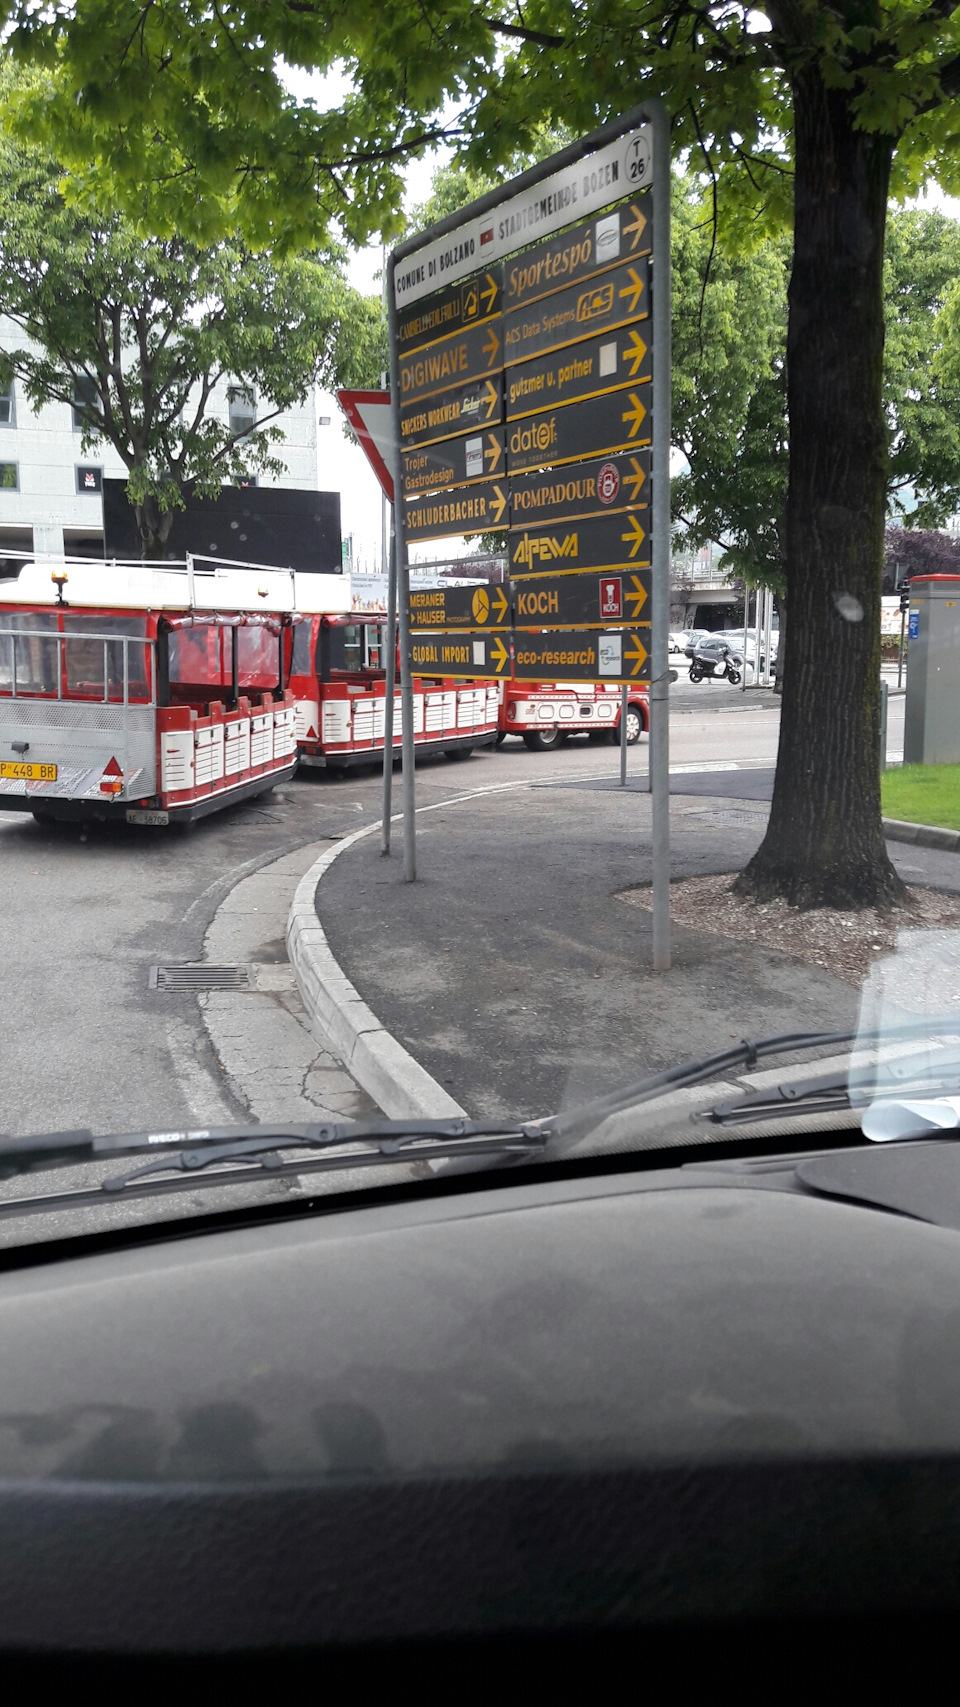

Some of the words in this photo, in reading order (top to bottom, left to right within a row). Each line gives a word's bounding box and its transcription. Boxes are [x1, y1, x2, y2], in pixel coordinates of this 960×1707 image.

[633, 140, 640, 157] T
[630, 157, 645, 178] 26
[499, 186, 577, 239] STADTGEMEINDE
[583, 160, 619, 198] BOZEN
[396, 267, 426, 293] COMUNE
[429, 260, 436, 277] DI
[440, 238, 475, 272] BOLZANO
[509, 230, 591, 296] Sportespó
[506, 329, 521, 345] ACS
[522, 321, 541, 341] Data
[543, 309, 575, 334] Systems
[401, 344, 468, 391] DIGIWAVE
[510, 375, 545, 402] gutzmer
[548, 373, 556, 387] u.
[558, 358, 592, 389] partner
[428, 402, 460, 426] WORKWEAR
[405, 456, 428, 471] Trojer
[405, 468, 454, 489] Gastrodesign
[514, 478, 595, 511] POMPADOUR
[406, 498, 486, 529] SCHLUDERBACHER
[410, 593, 445, 607] MERANER
[518, 591, 559, 615] KOCH
[603, 603, 620, 612] KOCH
[417, 610, 446, 624] HAUSER
[412, 646, 438, 663] GLOBAL
[442, 646, 470, 663] IMPORT
[517, 648, 595, 664] eco-research
[13, 765, 33, 777] 448
[40, 766, 54, 778] BR
